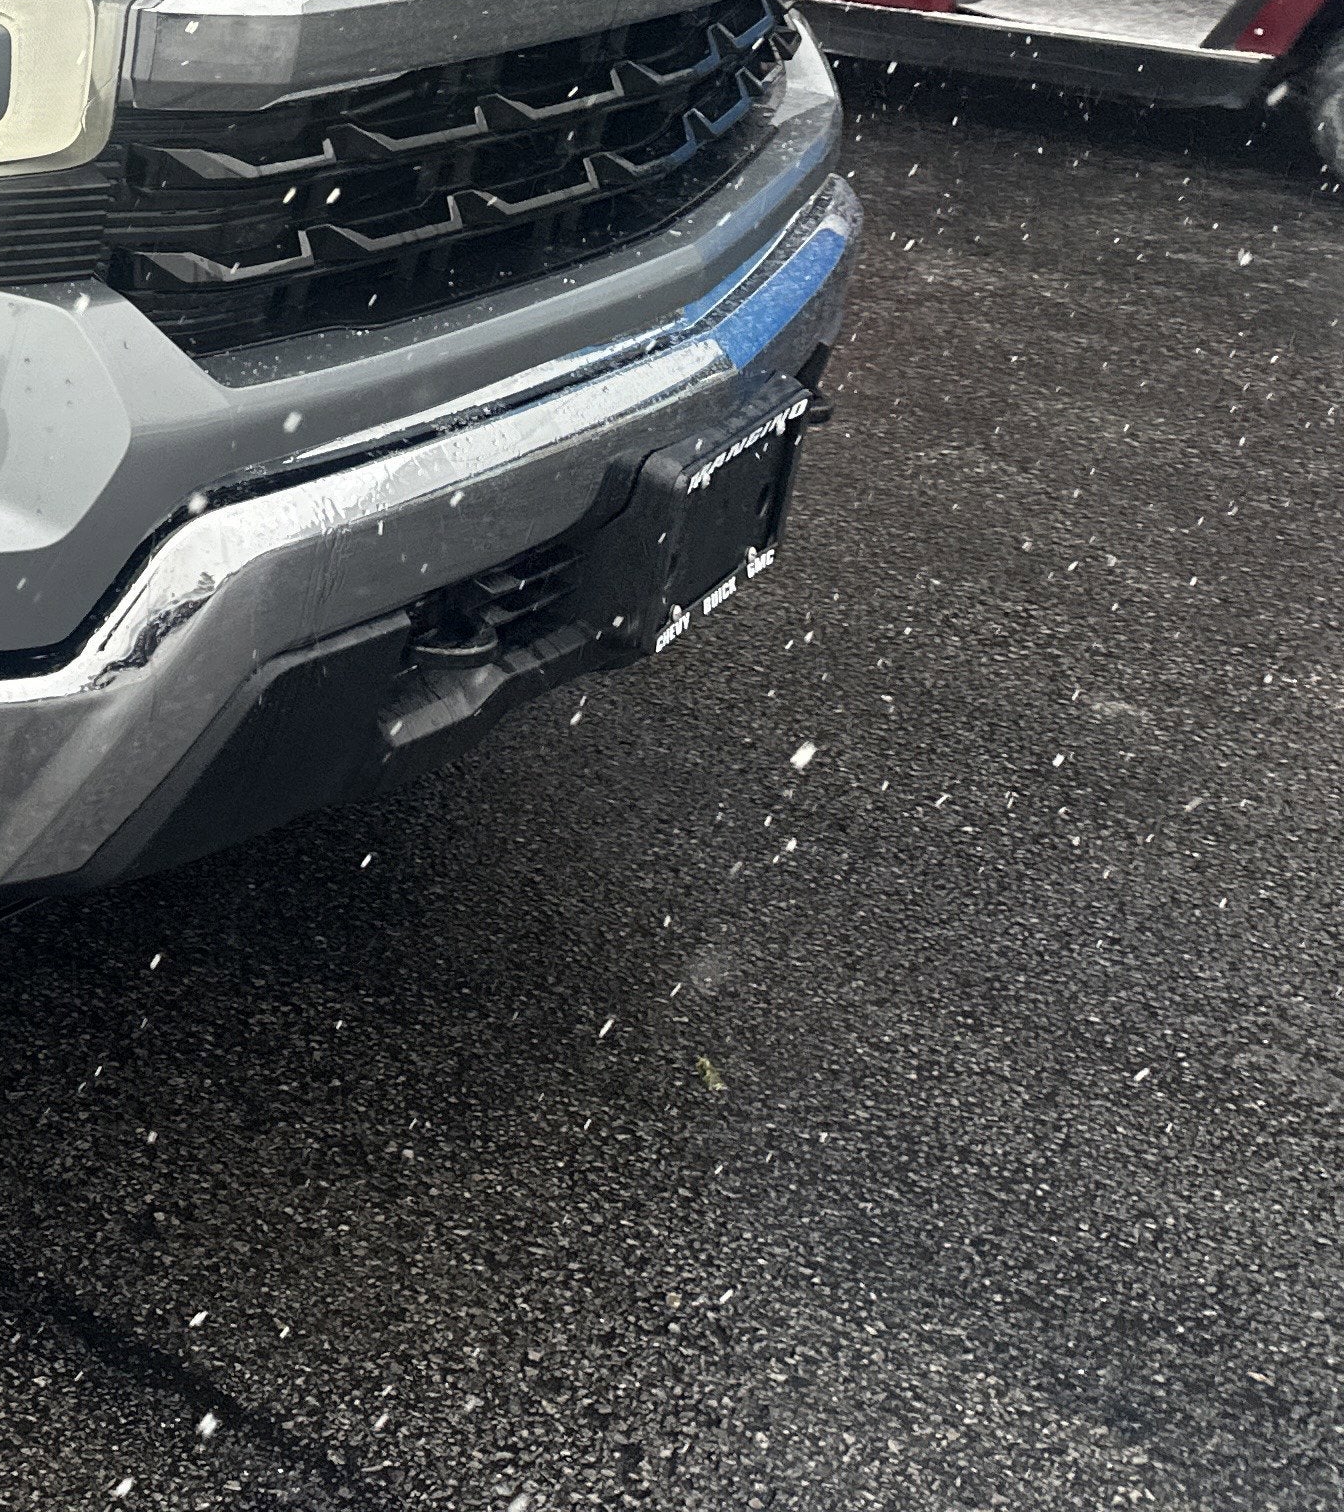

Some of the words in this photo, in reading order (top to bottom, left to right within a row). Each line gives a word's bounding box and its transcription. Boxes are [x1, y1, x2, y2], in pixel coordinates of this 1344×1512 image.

[655, 612, 690, 653] CHEVY
[703, 576, 736, 615] BUICK
[746, 549, 775, 578] GMC
